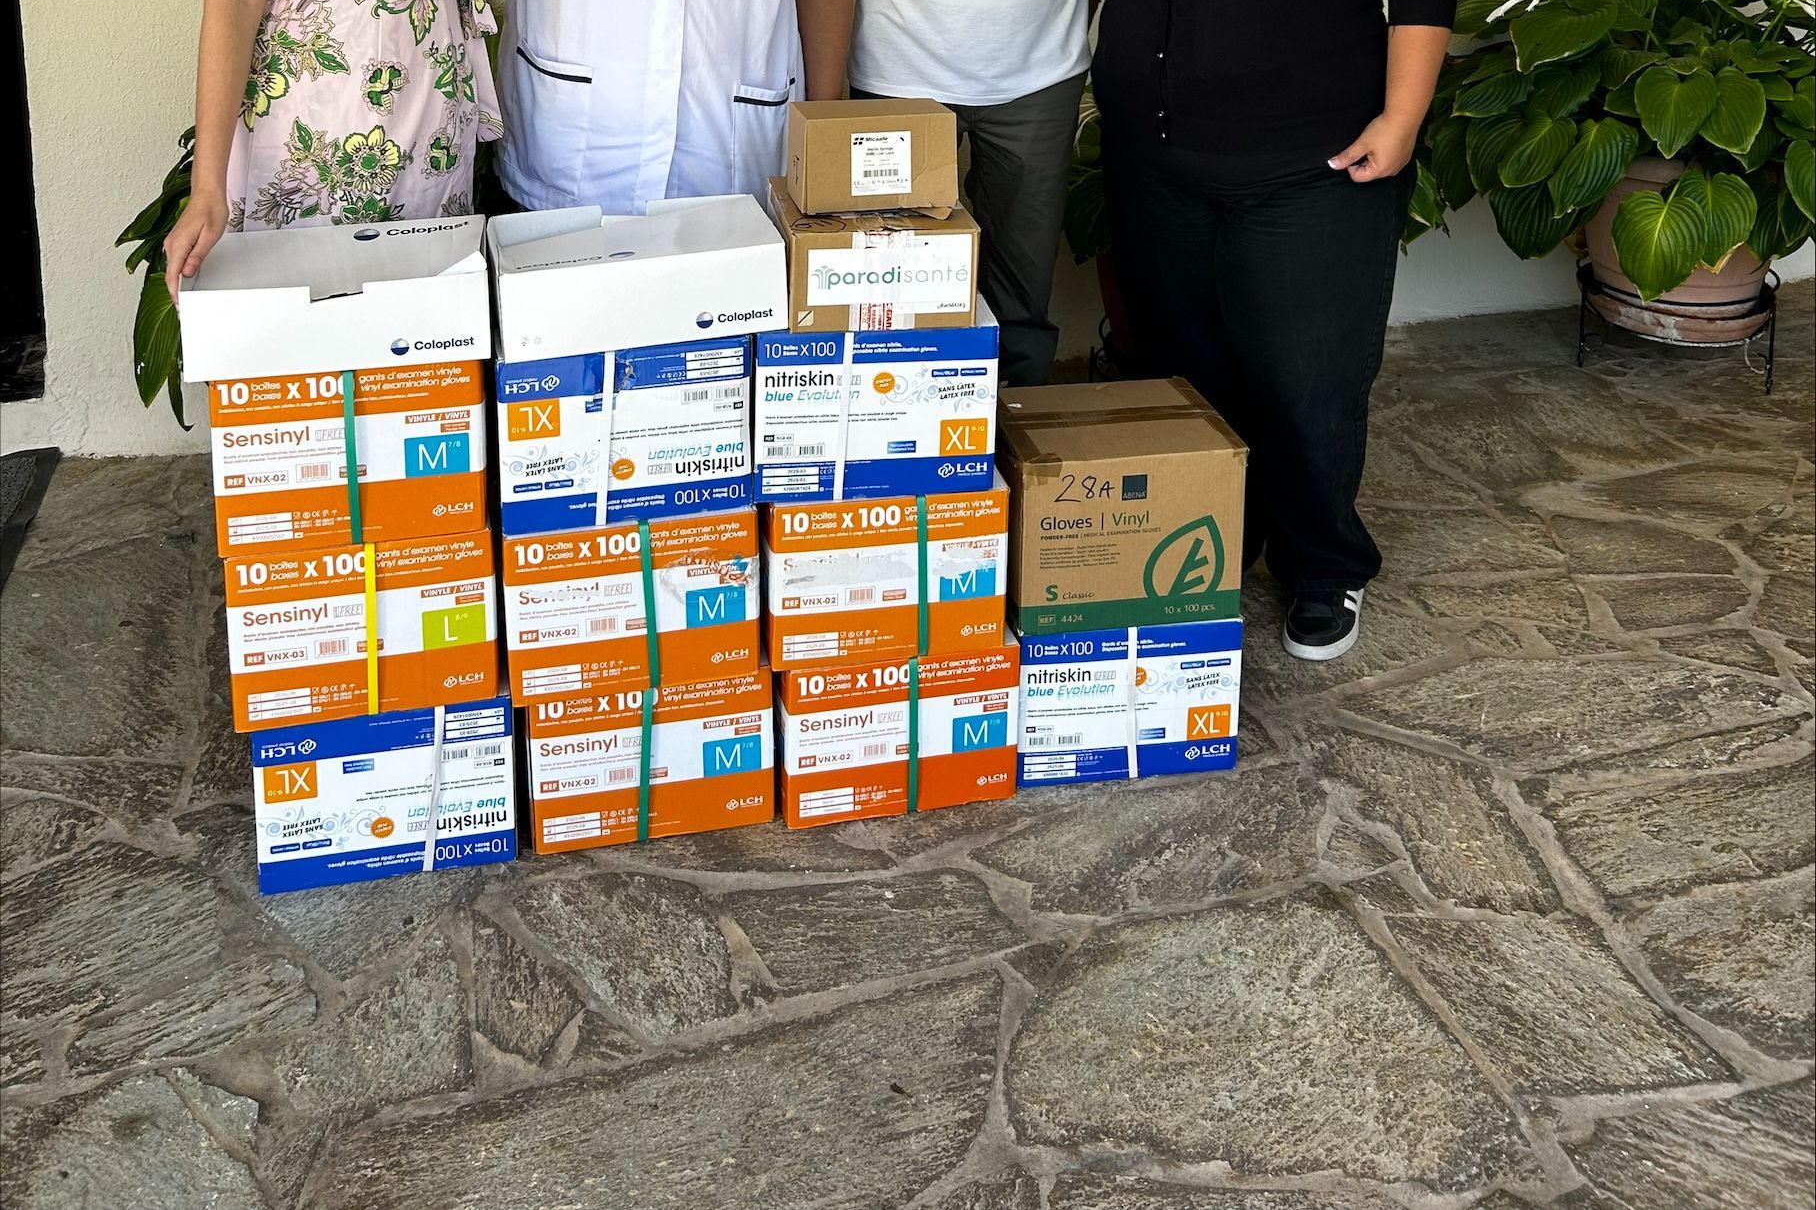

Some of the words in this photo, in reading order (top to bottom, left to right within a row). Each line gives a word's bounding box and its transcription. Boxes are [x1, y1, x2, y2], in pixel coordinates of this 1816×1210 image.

[386, 221, 470, 237] Coloplast
[827, 264, 968, 290] paradisanté
[717, 308, 773, 324] Coloplast
[414, 336, 475, 351] Coloplast
[765, 370, 834, 388] nitriskin
[505, 381, 539, 395] LCH
[938, 385, 955, 393] SANS
[957, 382, 976, 391] LATEX
[940, 391, 959, 400] LATEX
[765, 390, 793, 402] blue
[519, 404, 554, 431] XL
[222, 426, 310, 448] Sensinyl
[945, 425, 976, 451] XL
[418, 443, 448, 471] M
[648, 445, 712, 461] Evolution
[716, 441, 744, 457] blue
[675, 455, 745, 476] nitriskin
[956, 462, 988, 473] LCH
[247, 474, 286, 484] VNX-02
[448, 501, 474, 513] LCH
[1040, 516, 1092, 531] Gloves
[1112, 510, 1150, 527] Vinyl
[514, 543, 544, 567] 10
[596, 532, 641, 555] 100
[802, 596, 837, 606] VNX-02
[1046, 584, 1059, 602] S
[1062, 590, 1095, 600] Classic
[243, 603, 328, 627] Sensinyl
[700, 593, 725, 621] M
[1164, 606, 1174, 614] 10
[1185, 603, 1199, 612] 100
[1061, 614, 1082, 623] 4424
[443, 615, 458, 641] L
[541, 628, 576, 639] VNX-02
[267, 650, 305, 661] VNX-03
[725, 648, 749, 660] LCH
[459, 672, 484, 682] LCH
[1027, 668, 1091, 684] nitriskin
[1027, 686, 1054, 697] blue
[1057, 683, 1115, 696] Evolution
[799, 710, 873, 732] Sensinyl
[1192, 713, 1220, 735] XL
[964, 722, 988, 747] M
[261, 743, 296, 759] LCH
[540, 735, 617, 757] Sensinyl
[1202, 744, 1230, 755] LCH
[716, 746, 741, 771] M
[818, 753, 851, 764] VNX-02
[275, 767, 311, 795] XL
[561, 778, 596, 789] VNX-02
[988, 773, 1007, 782] LCH
[476, 796, 506, 810] blue
[740, 796, 764, 805] LCH
